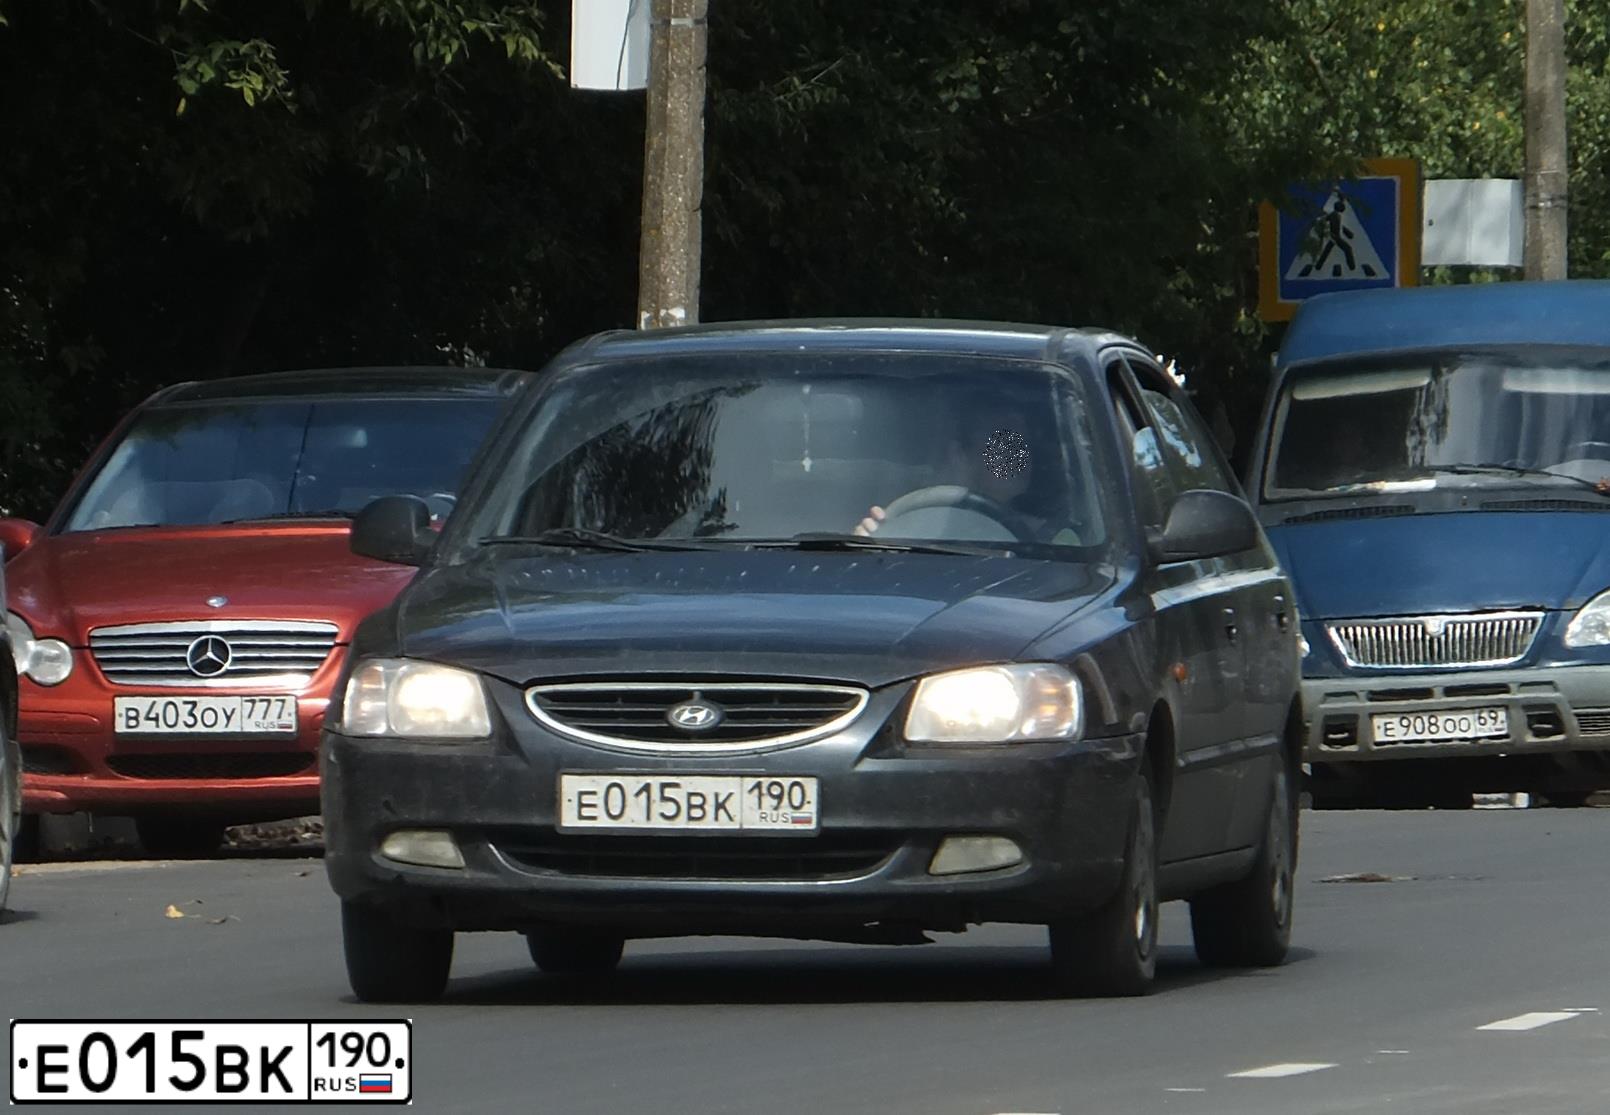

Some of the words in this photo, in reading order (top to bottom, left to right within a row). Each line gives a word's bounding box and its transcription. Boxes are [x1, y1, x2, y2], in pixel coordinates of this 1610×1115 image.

[125, 700, 236, 729] В403ОУ
[244, 699, 286, 720] 777
[254, 721, 276, 729] RUS
[1384, 714, 1471, 737] Е908ОО
[1478, 709, 1499, 726] 69
[576, 782, 736, 822] Е015ВК
[748, 780, 807, 811] 190
[759, 812, 789, 823] RUS
